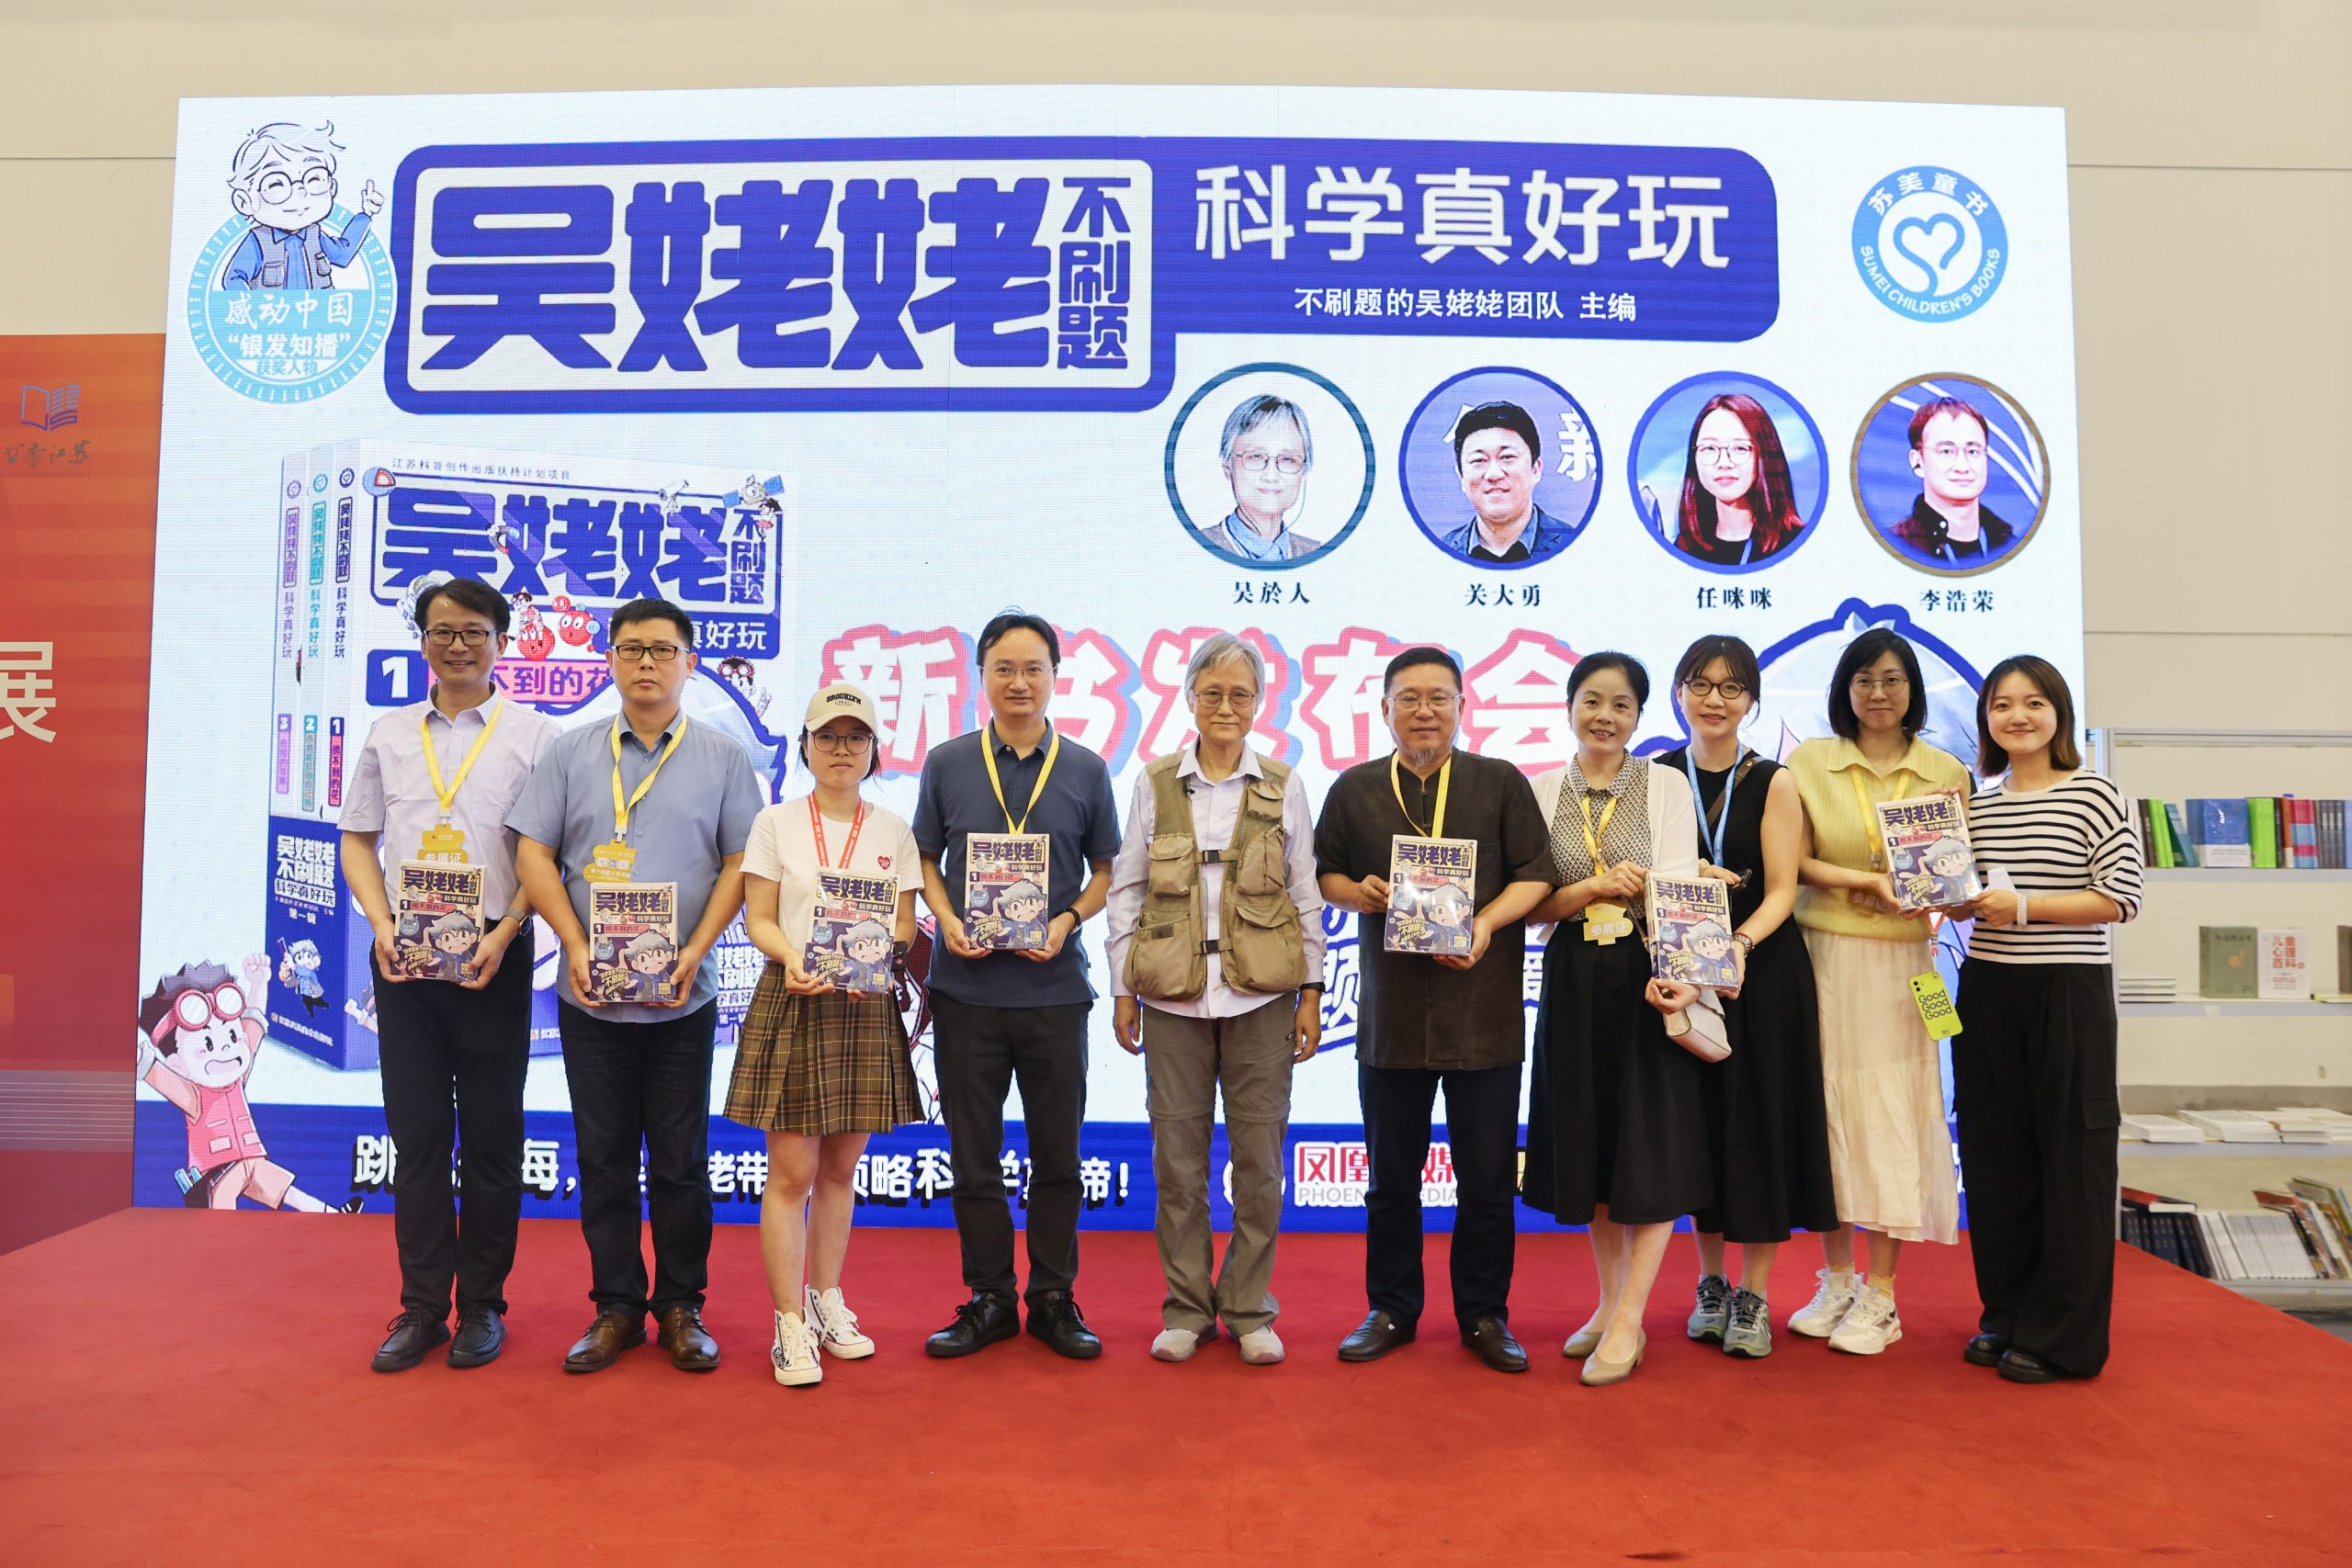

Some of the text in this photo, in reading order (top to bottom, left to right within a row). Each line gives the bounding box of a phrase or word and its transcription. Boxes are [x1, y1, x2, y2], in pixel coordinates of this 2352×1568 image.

[1868, 172, 1988, 216] 苏美童书
[1195, 164, 1730, 268] 科学真好玩
[421, 177, 1050, 371] 吴姥姥
[1057, 177, 1131, 368] 不刷题
[1860, 245, 2000, 314] SUMEI CHILDREN'S BOOKS
[224, 291, 353, 330] 感动中国
[1295, 288, 1636, 322] 不刷题的吴姥姥团队 主编
[382, 489, 726, 602] 吴姥姥
[1233, 581, 1310, 604] 吴於人
[1464, 583, 1541, 606] 关大勇
[1697, 586, 1772, 610] 任咪咪
[1919, 589, 1994, 613] 李浩荣
[334, 587, 347, 658] 科学真好玩
[380, 657, 410, 698] 1
[826, 693, 861, 705] BROOKLYN
[305, 717, 314, 730] 2
[333, 718, 341, 734] 1
[1884, 802, 1948, 826] 吴姥姥
[972, 841, 1035, 861] 吴姥姥
[1397, 844, 1462, 866] 吴姥姥
[403, 869, 469, 893] 吴姥姥
[820, 875, 885, 901] 吴姥姥
[596, 892, 661, 912] 吴姥姥
[1918, 988, 1946, 1003] Good
[1922, 997, 1949, 1011] Good
[1925, 1005, 1952, 1020] Good
[1299, 1147, 1453, 1183] 凤凰媒
[1298, 1187, 1458, 1202] PHOEN EDIA
